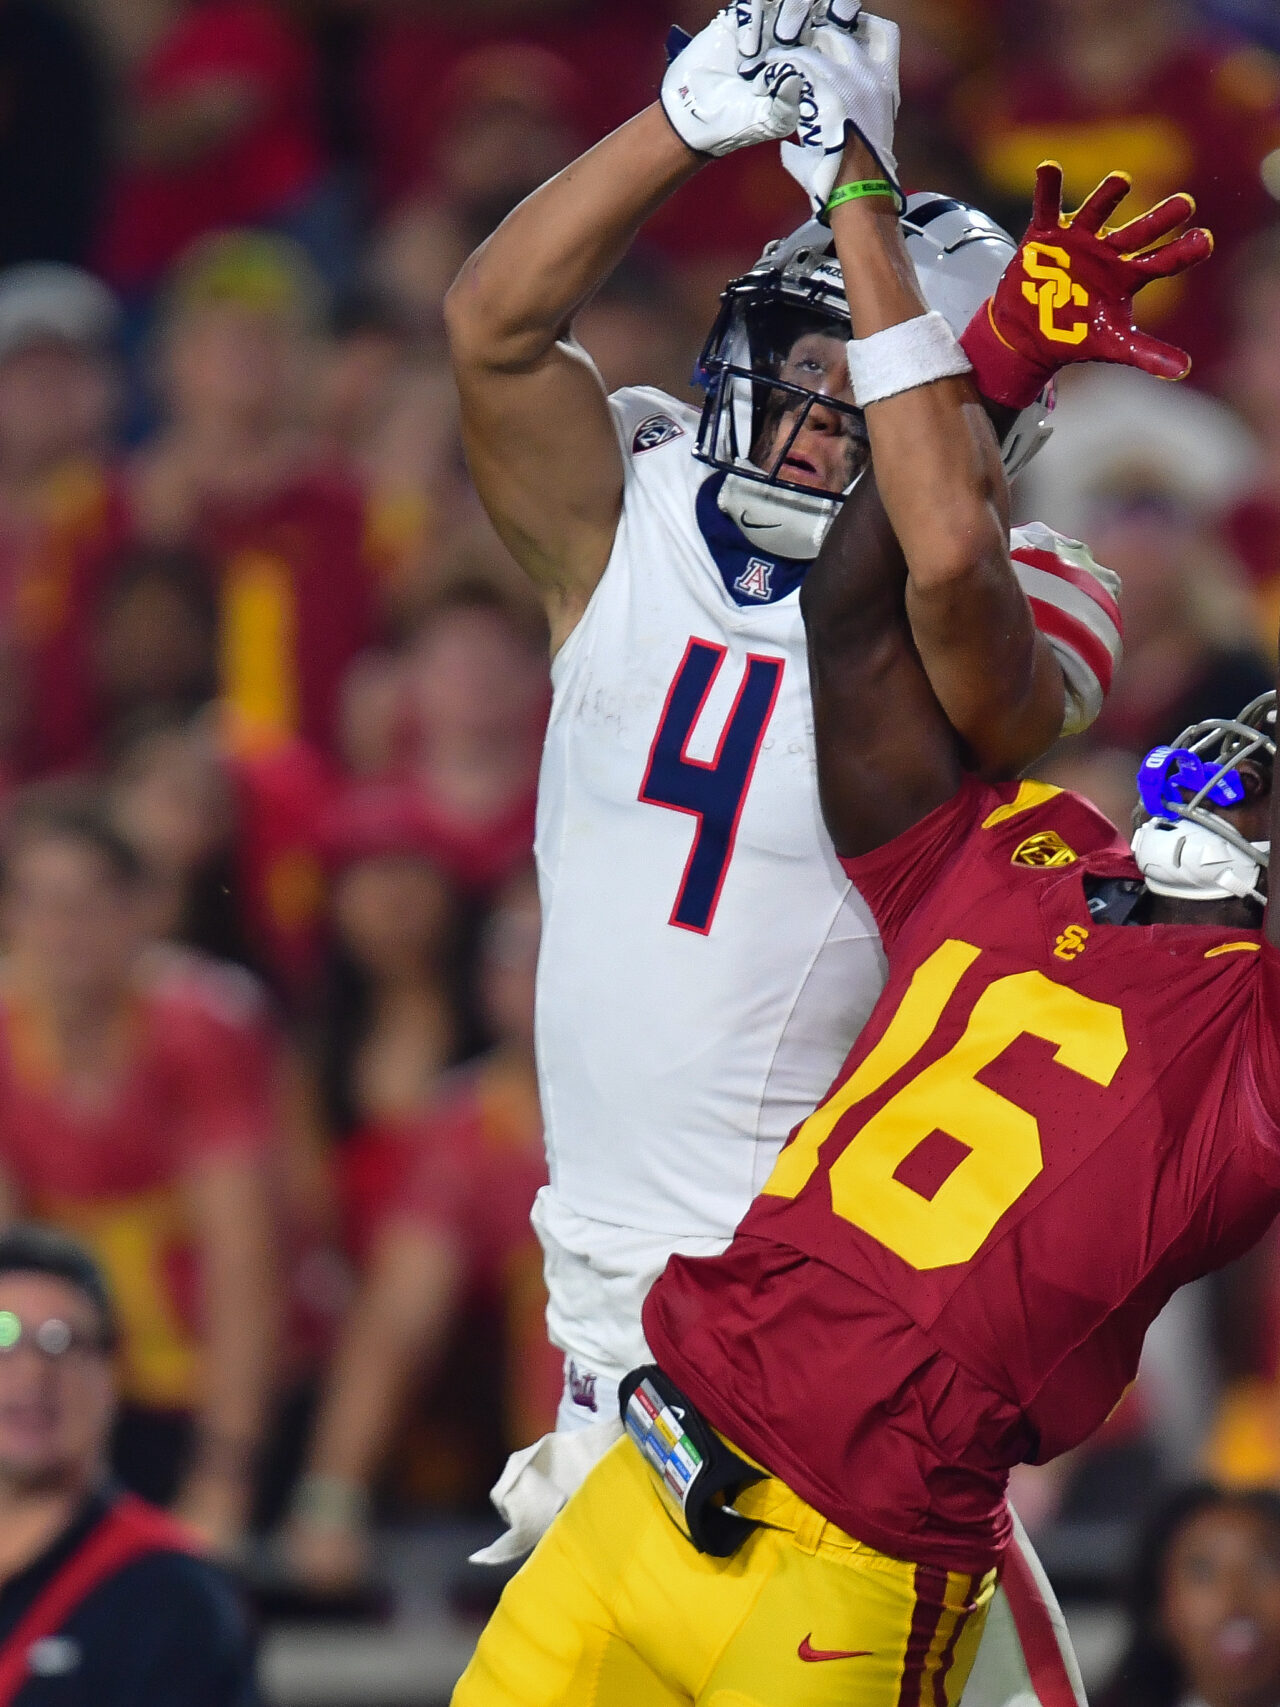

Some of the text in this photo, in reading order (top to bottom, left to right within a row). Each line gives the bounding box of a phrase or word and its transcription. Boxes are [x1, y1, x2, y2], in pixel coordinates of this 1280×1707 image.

[1021, 241, 1088, 345] SC
[733, 556, 775, 600] A
[637, 635, 785, 936] 4
[1053, 924, 1088, 960] SC
[760, 939, 1128, 1270] 16
